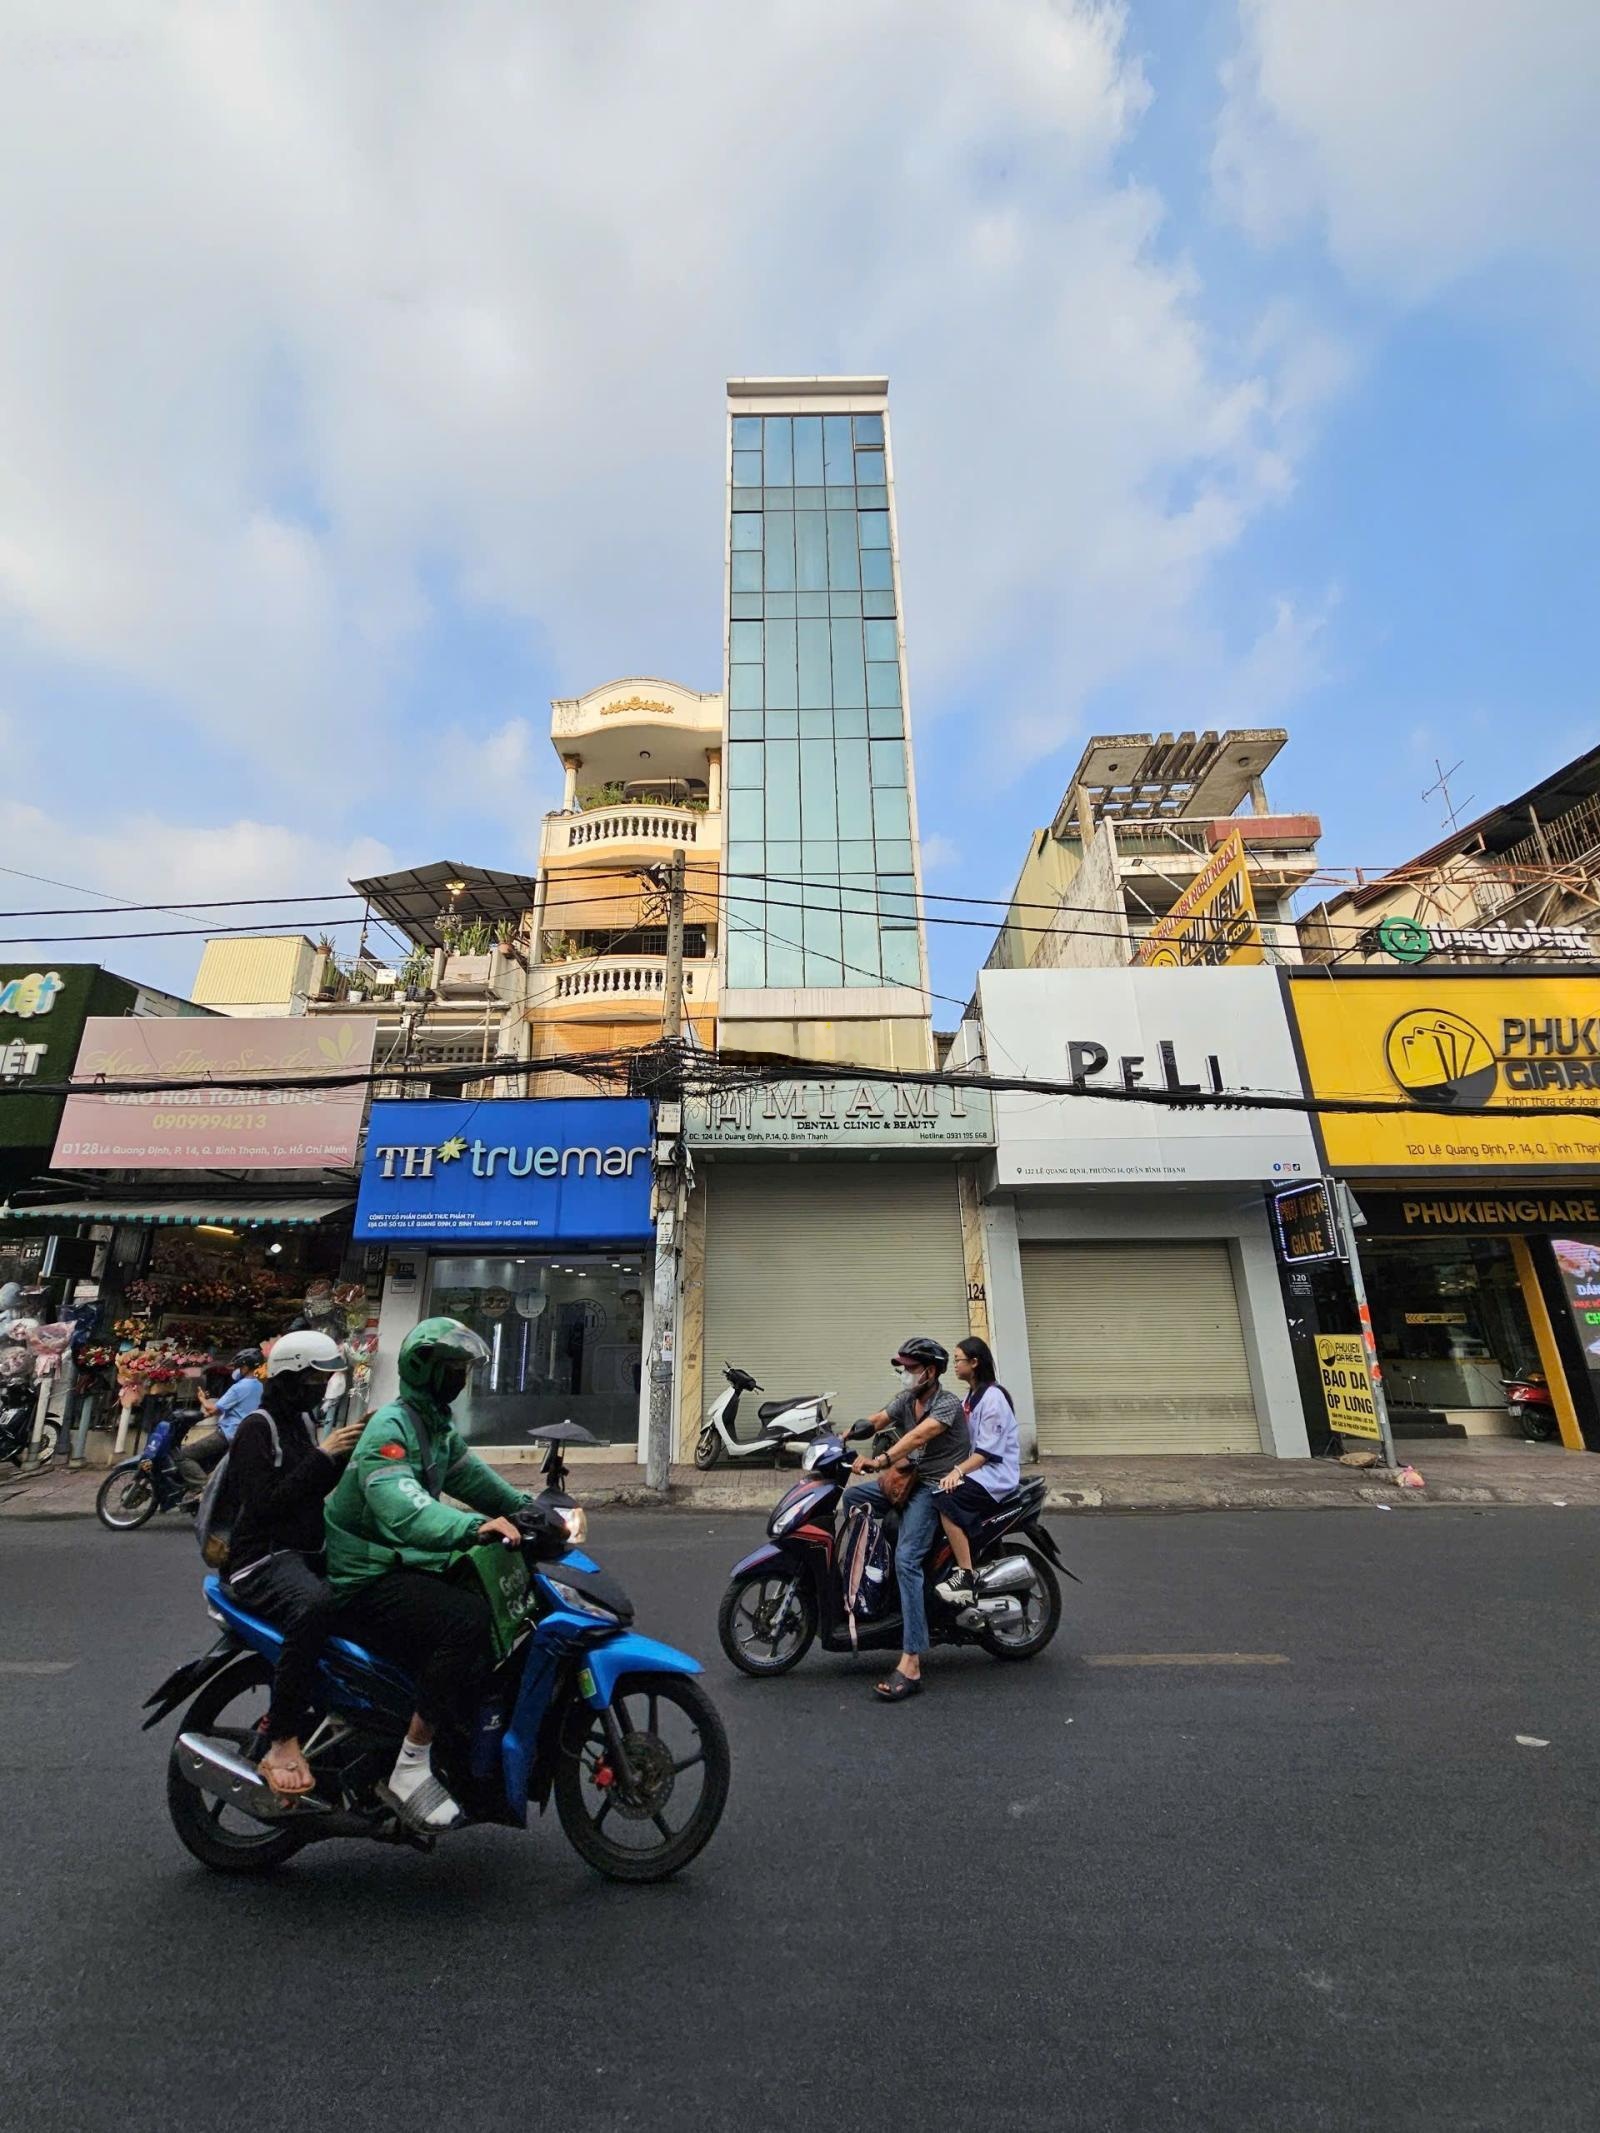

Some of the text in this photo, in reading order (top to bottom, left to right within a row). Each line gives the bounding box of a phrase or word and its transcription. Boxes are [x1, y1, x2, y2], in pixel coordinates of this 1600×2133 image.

[1502, 1018, 1600, 1056] PHUK
[762, 1079, 968, 1119] MIAMI
[152, 1113, 267, 1131] 0909994213
[797, 1121, 936, 1130] DENTAL CLINIC & BEAUTY
[724, 1133, 746, 1142] Quang
[76, 1142, 99, 1155] 128
[112, 1145, 146, 1157] Quang
[1407, 1144, 1424, 1155] 120
[1429, 1143, 1442, 1155] Lê
[1445, 1144, 1479, 1157] Quang
[376, 1146, 437, 1178] TH
[1402, 1198, 1600, 1225] PHUKIENGIARE
[1291, 1274, 1307, 1282] 120
[968, 1283, 986, 1300] 124
[1321, 1368, 1369, 1391] BAO DA
[1326, 1388, 1374, 1415] ỐP LƯNG
[398, 1477, 433, 1511] Gra
